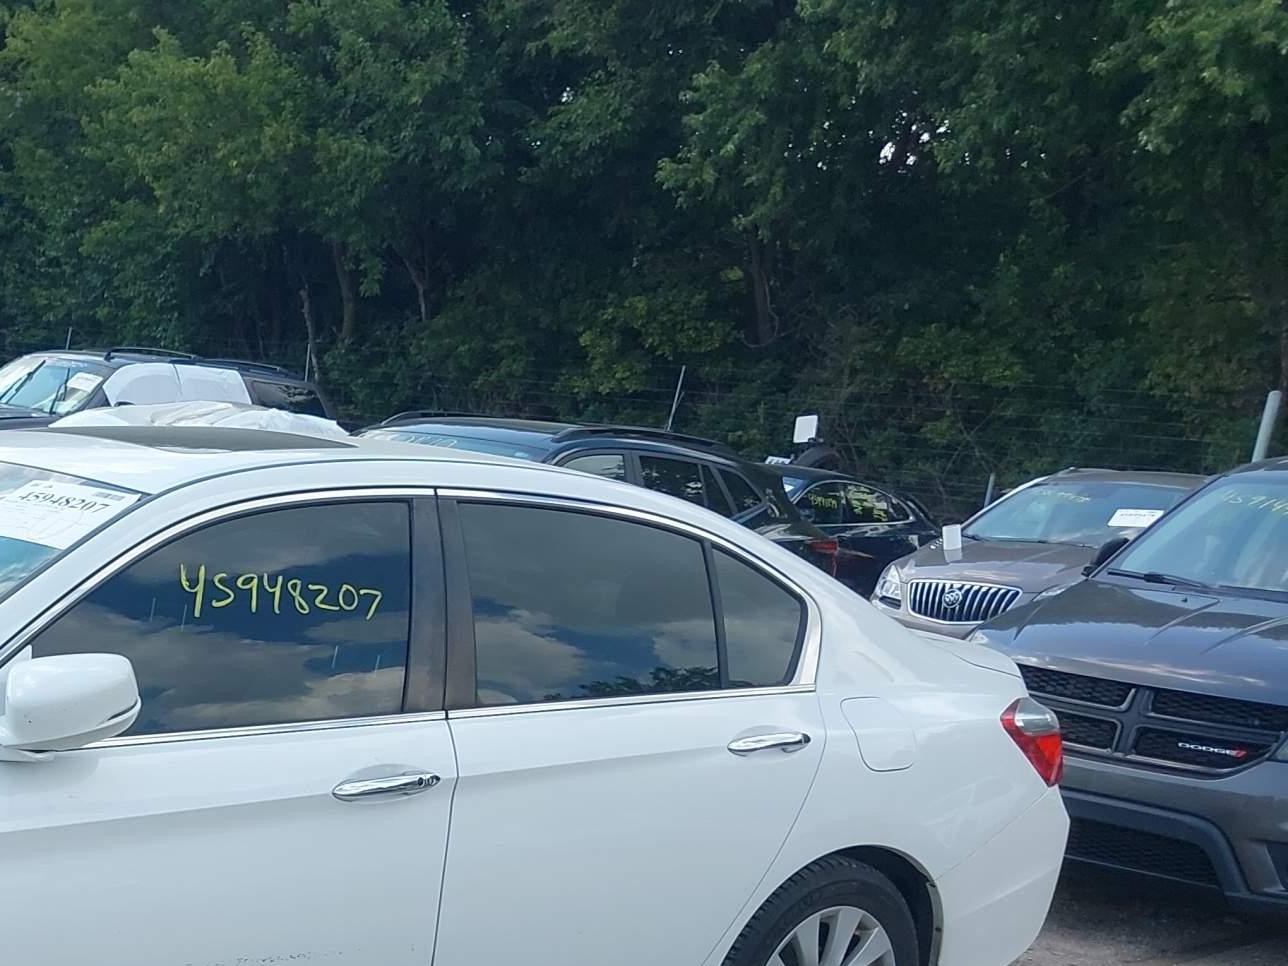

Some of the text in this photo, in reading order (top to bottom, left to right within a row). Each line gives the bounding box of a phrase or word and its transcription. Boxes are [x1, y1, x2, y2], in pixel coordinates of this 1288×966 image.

[18, 491, 112, 513] 45948207
[180, 563, 383, 620] 45948207
[1177, 742, 1236, 757] DODGE
